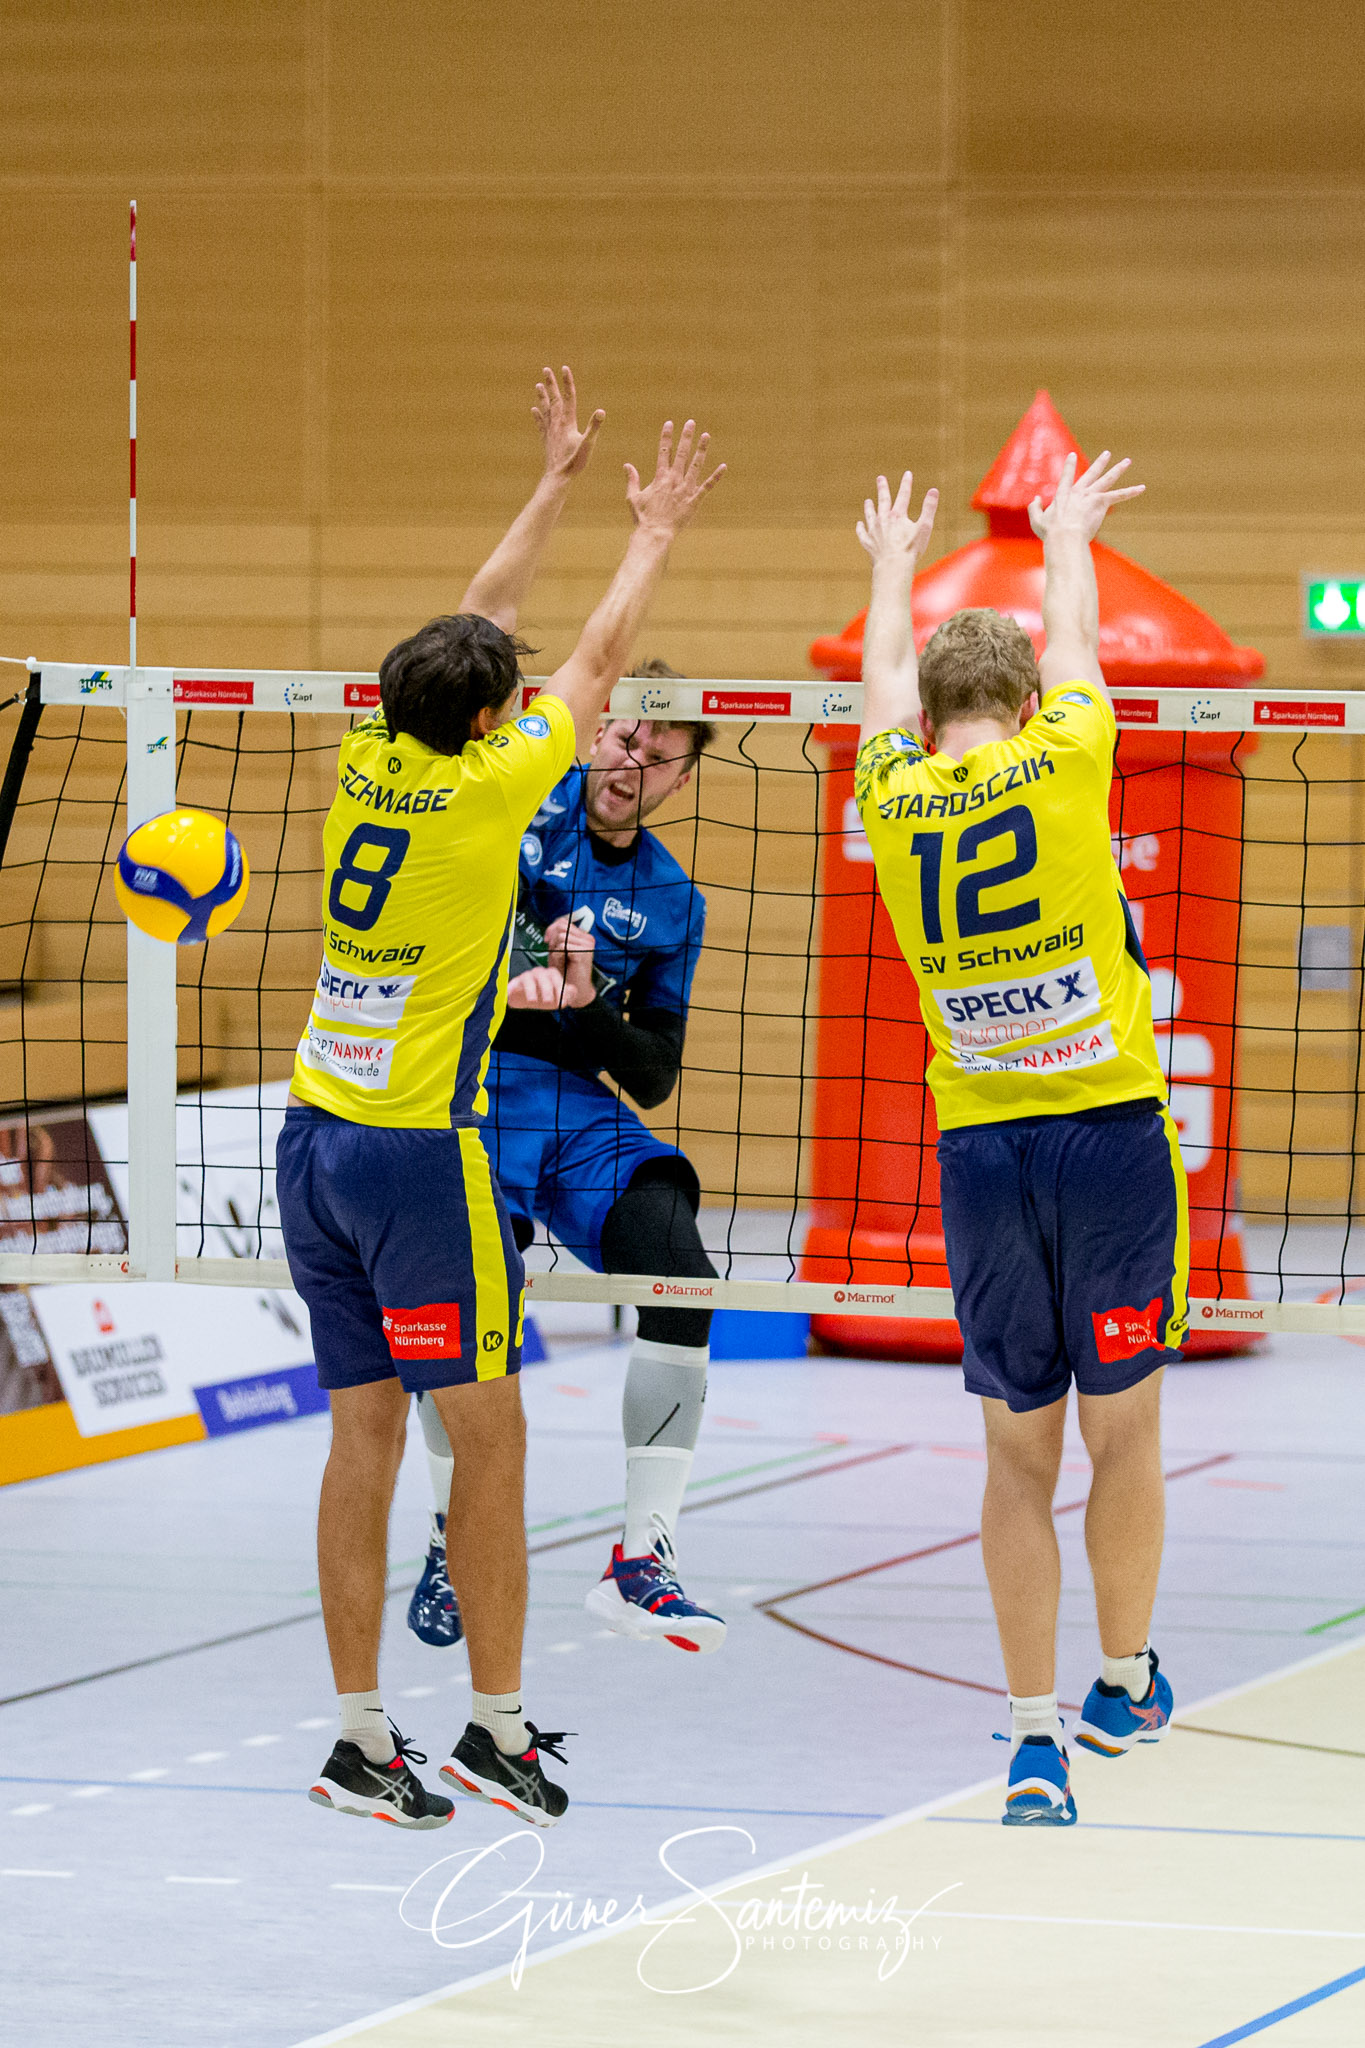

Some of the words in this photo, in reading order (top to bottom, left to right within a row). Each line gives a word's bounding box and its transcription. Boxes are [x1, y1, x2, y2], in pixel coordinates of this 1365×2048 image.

[217, 690, 248, 701] Nürnberg
[293, 692, 313, 702] Zapf
[362, 693, 383, 703] Spark
[649, 700, 671, 710] Zapf
[720, 701, 753, 711] Sparkasse
[754, 702, 785, 712] Nürnberg
[831, 703, 852, 714] Zapf
[1120, 708, 1153, 719] Nürnberg
[1199, 711, 1221, 721] Zapf
[1272, 710, 1307, 721] Sparkasse
[1307, 711, 1340, 723] Nürnberg
[340, 763, 454, 815] SCHWABE
[878, 751, 1056, 820] STAROSCZIK
[328, 822, 412, 932] 8
[910, 804, 1041, 945] 12
[329, 930, 427, 966] Schwaig
[920, 955, 946, 974] SV
[958, 923, 1084, 971] Schwaig
[946, 983, 1052, 1023] SPECK
[666, 1284, 714, 1297] Marmot
[847, 1292, 896, 1304] Marmot
[1215, 1308, 1265, 1320] Marmot
[394, 1321, 447, 1333] Sparkasse
[394, 1335, 445, 1347] Nürnberg
